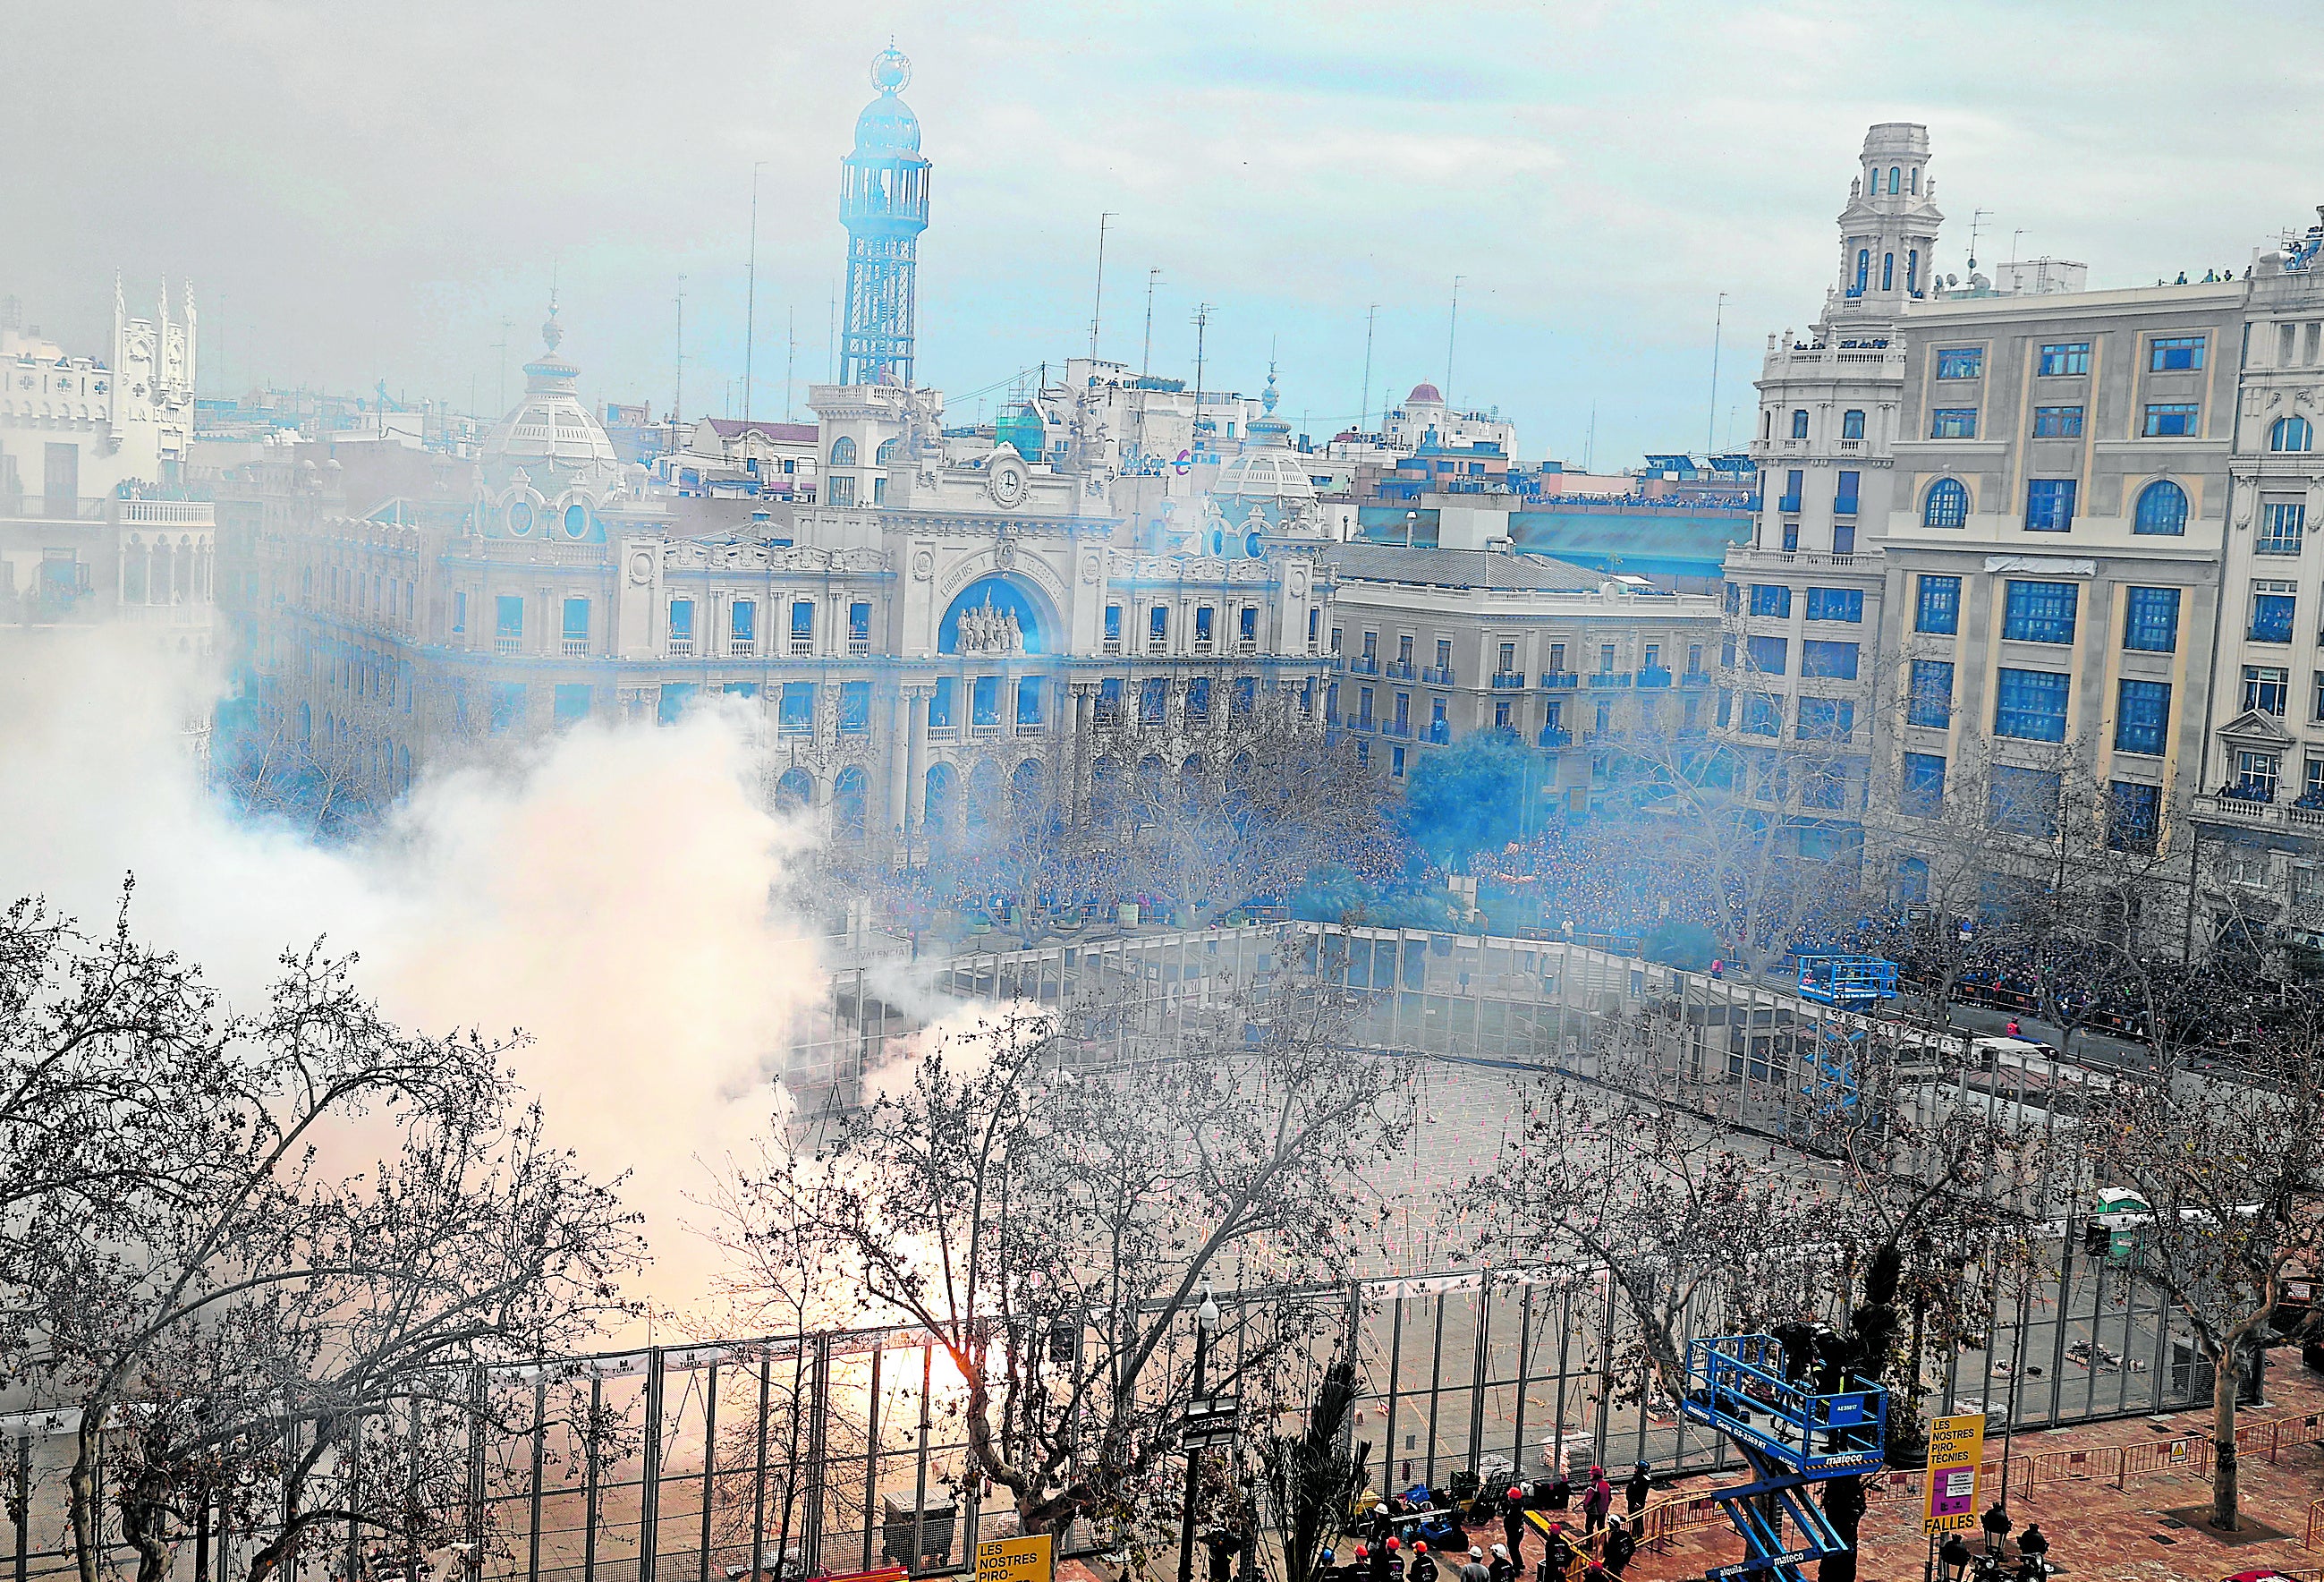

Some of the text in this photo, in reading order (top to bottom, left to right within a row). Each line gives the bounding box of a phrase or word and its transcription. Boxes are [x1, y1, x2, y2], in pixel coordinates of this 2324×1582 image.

[860, 948, 905, 961] VALENCIA
[612, 1365, 634, 1374] TURIA
[679, 1360, 702, 1368] TURIA
[1687, 1405, 1710, 1421] mateco
[1933, 1419, 1950, 1431] LES
[1932, 1428, 1974, 1442] NOSTRES
[1757, 1441, 1768, 1450] RT
[1931, 1442, 1957, 1453] PIRO-
[1825, 1453, 1863, 1466] mateco
[1930, 1450, 1969, 1464] TÈCNIES
[1924, 1514, 1974, 1534] FALLES
[980, 1544, 1003, 1557] LES
[980, 1552, 1038, 1569] NOSTRES
[1773, 1552, 1804, 1567] mateco
[979, 1569, 1014, 1582] PIRO-
